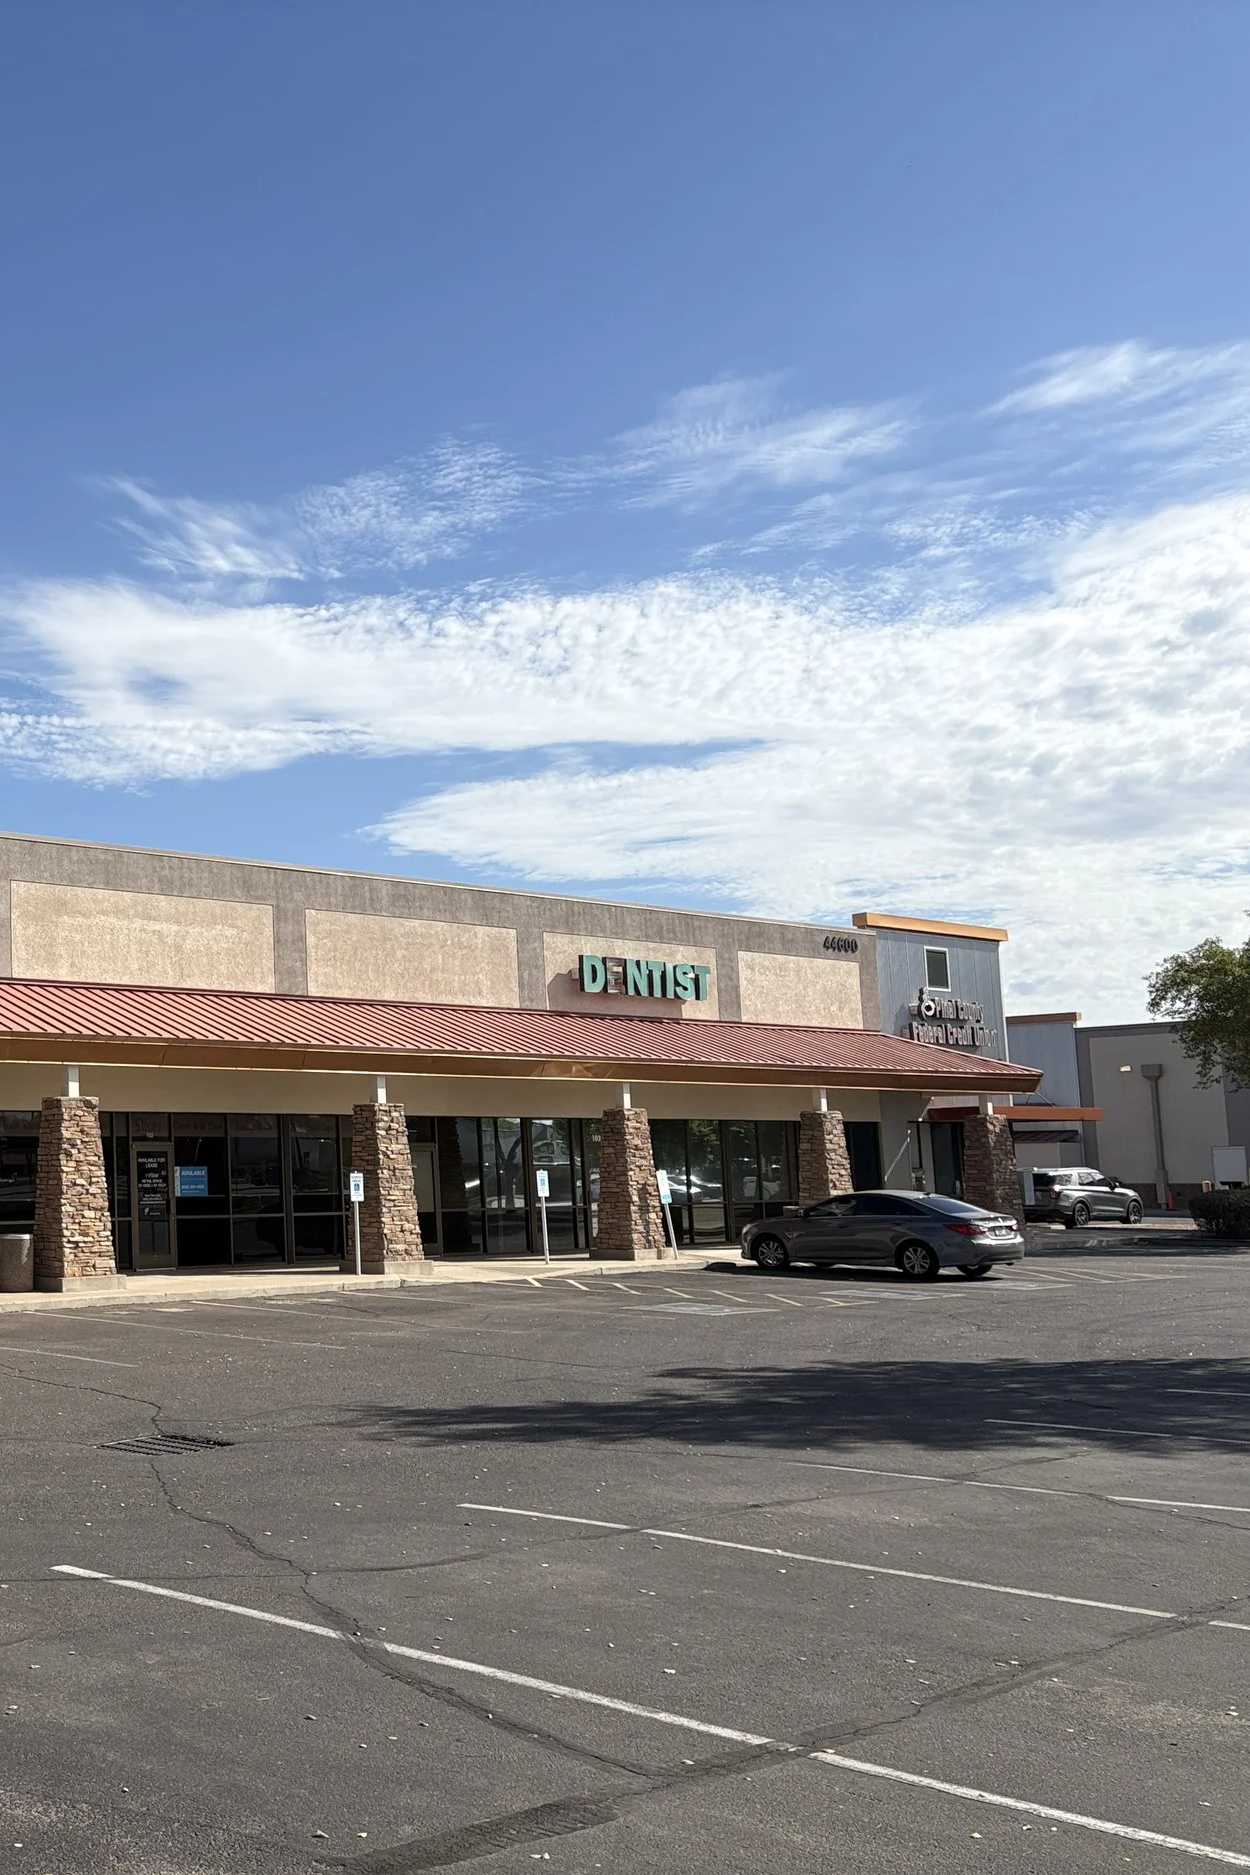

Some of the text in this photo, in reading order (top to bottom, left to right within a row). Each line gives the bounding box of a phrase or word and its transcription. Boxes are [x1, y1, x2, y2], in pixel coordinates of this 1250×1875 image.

[579, 955, 710, 1001] DENTIST
[934, 997, 985, 1024] Pinal County
[912, 1021, 997, 1048] Federal Credit Union
